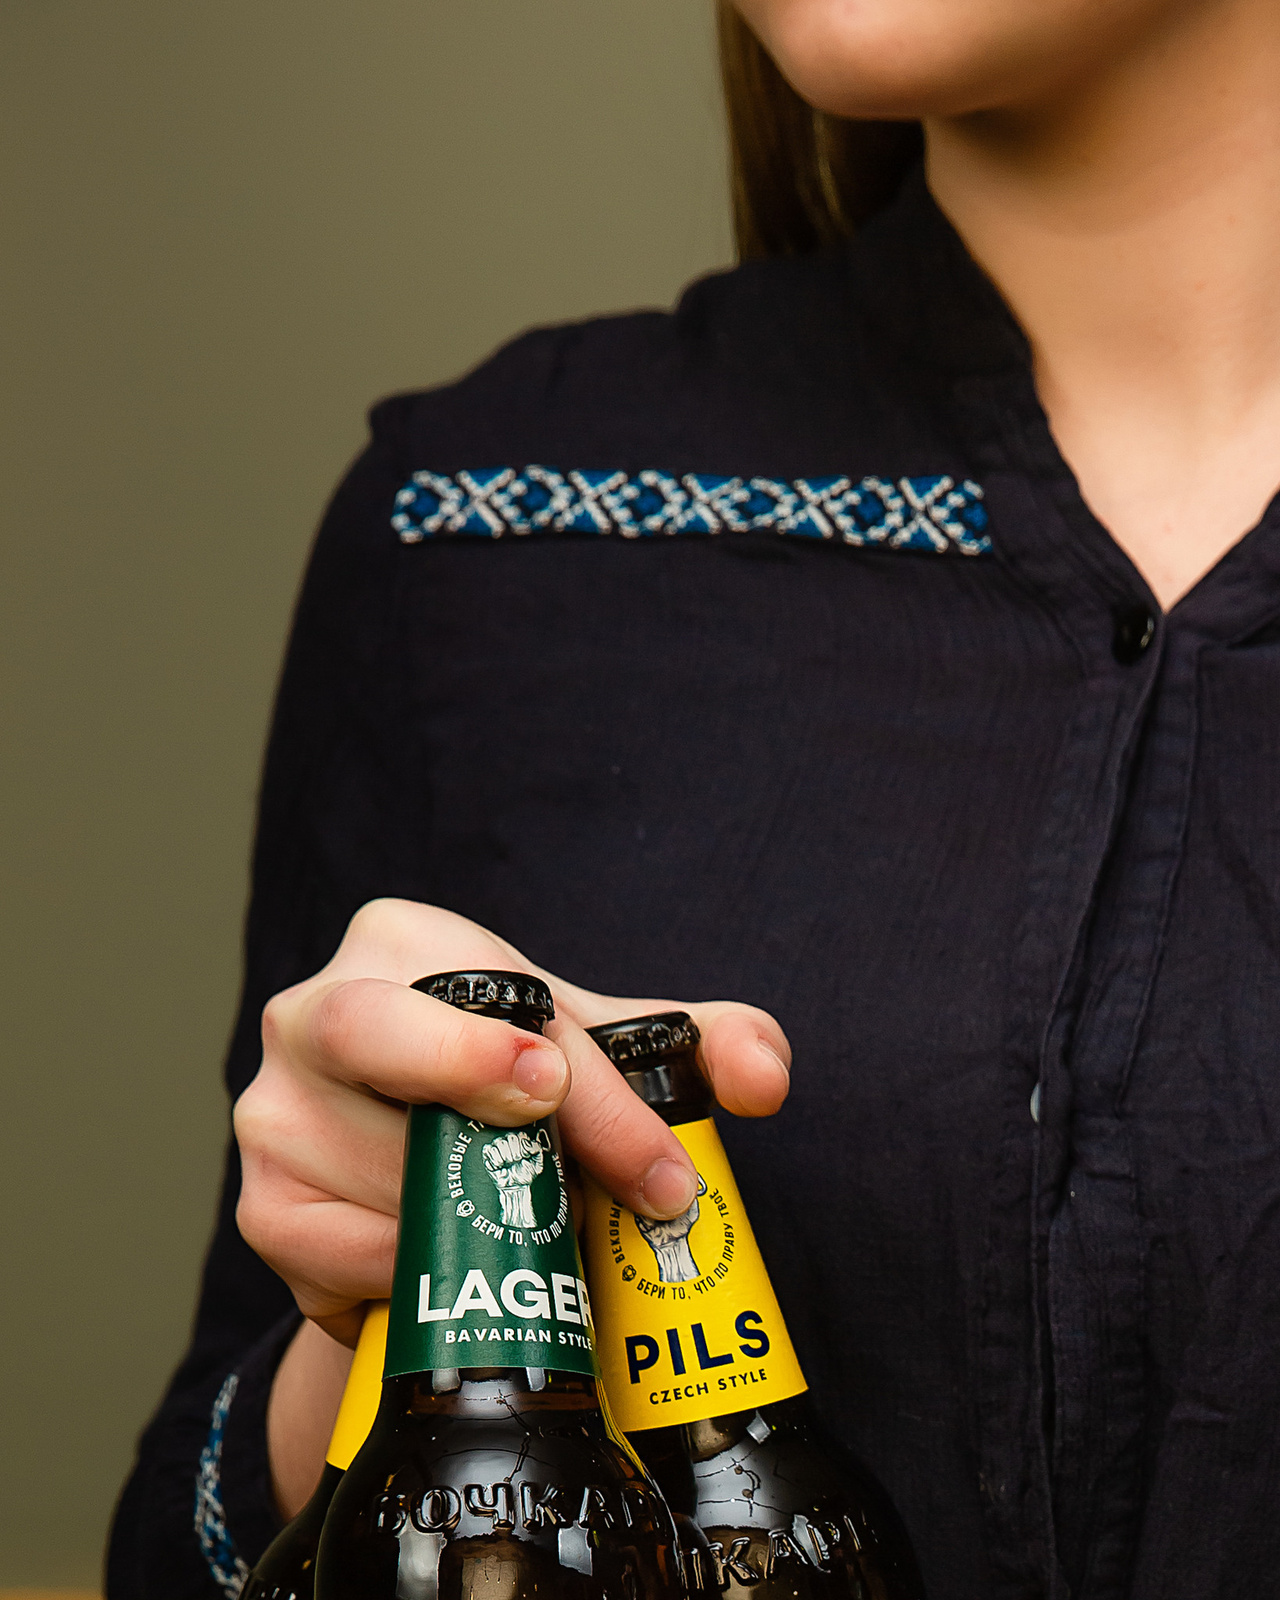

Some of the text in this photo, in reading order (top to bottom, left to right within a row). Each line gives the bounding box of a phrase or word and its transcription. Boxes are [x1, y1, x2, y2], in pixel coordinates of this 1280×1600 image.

[447, 1132, 473, 1199] ВЕКОВЫЕ
[471, 1214, 503, 1240] БЕРИ
[509, 1230, 529, 1247] ТО,
[531, 1230, 552, 1246] ЧТО
[550, 1220, 562, 1239] ПО
[557, 1187, 568, 1227] ПРАВУ
[636, 1278, 666, 1299] БЕРИ
[671, 1286, 692, 1301] ТО,
[695, 1276, 715, 1295] ЧТО
[713, 1262, 729, 1280] ПО
[722, 1222, 735, 1262] ПРАВУ
[417, 1269, 595, 1330] LAGER
[445, 1328, 593, 1351] BAVARIAN STYLE
[625, 1310, 770, 1385] PILS
[649, 1368, 768, 1406] CZECH STYLE
